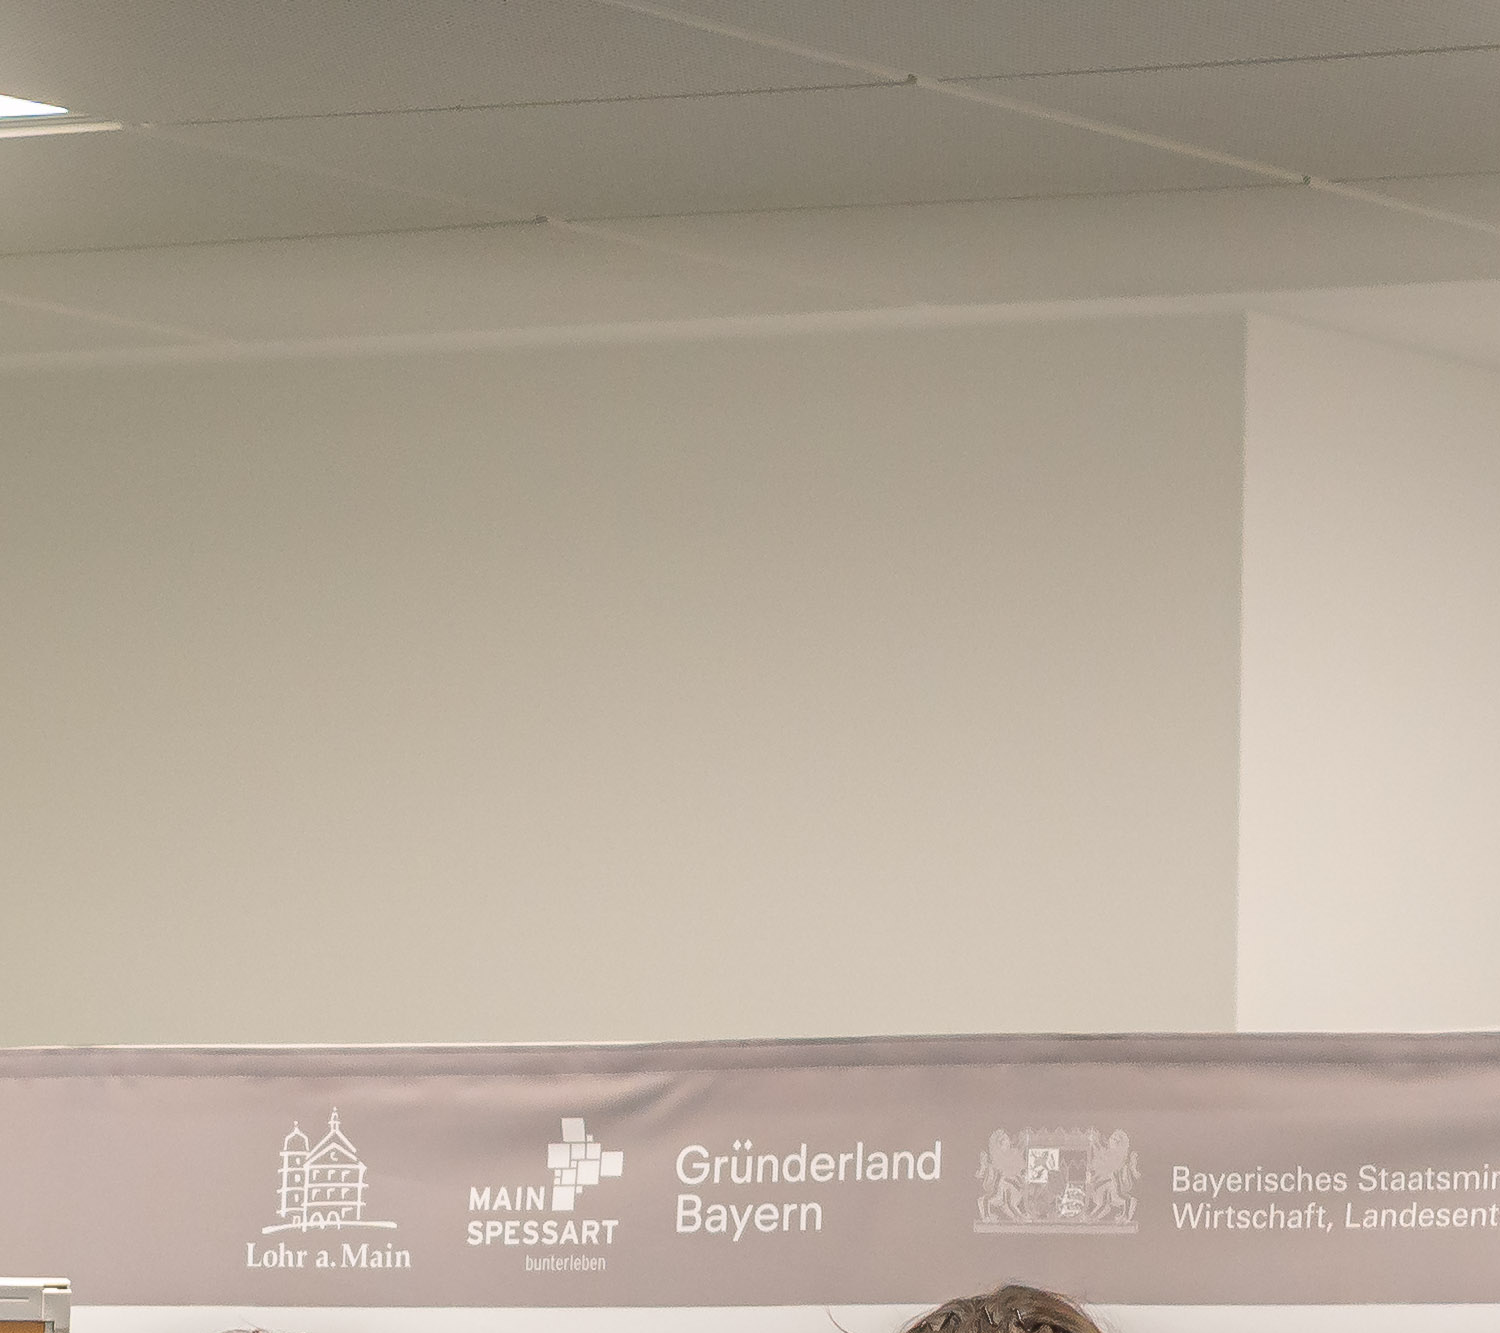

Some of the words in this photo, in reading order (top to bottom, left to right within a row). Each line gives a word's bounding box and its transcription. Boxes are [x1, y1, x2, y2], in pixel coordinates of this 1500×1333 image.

[676, 1138, 942, 1186] Gründerland
[1171, 1163, 1348, 1199] Bayerisches
[468, 1184, 546, 1212] MAIN
[676, 1193, 824, 1241] Bayern
[1172, 1198, 1335, 1233] Wirtschaft,
[467, 1218, 619, 1247] SPESSART
[246, 1243, 305, 1270] Lohr
[316, 1250, 336, 1269] a.
[340, 1243, 412, 1269] Main
[525, 1252, 607, 1272] bunterleben
